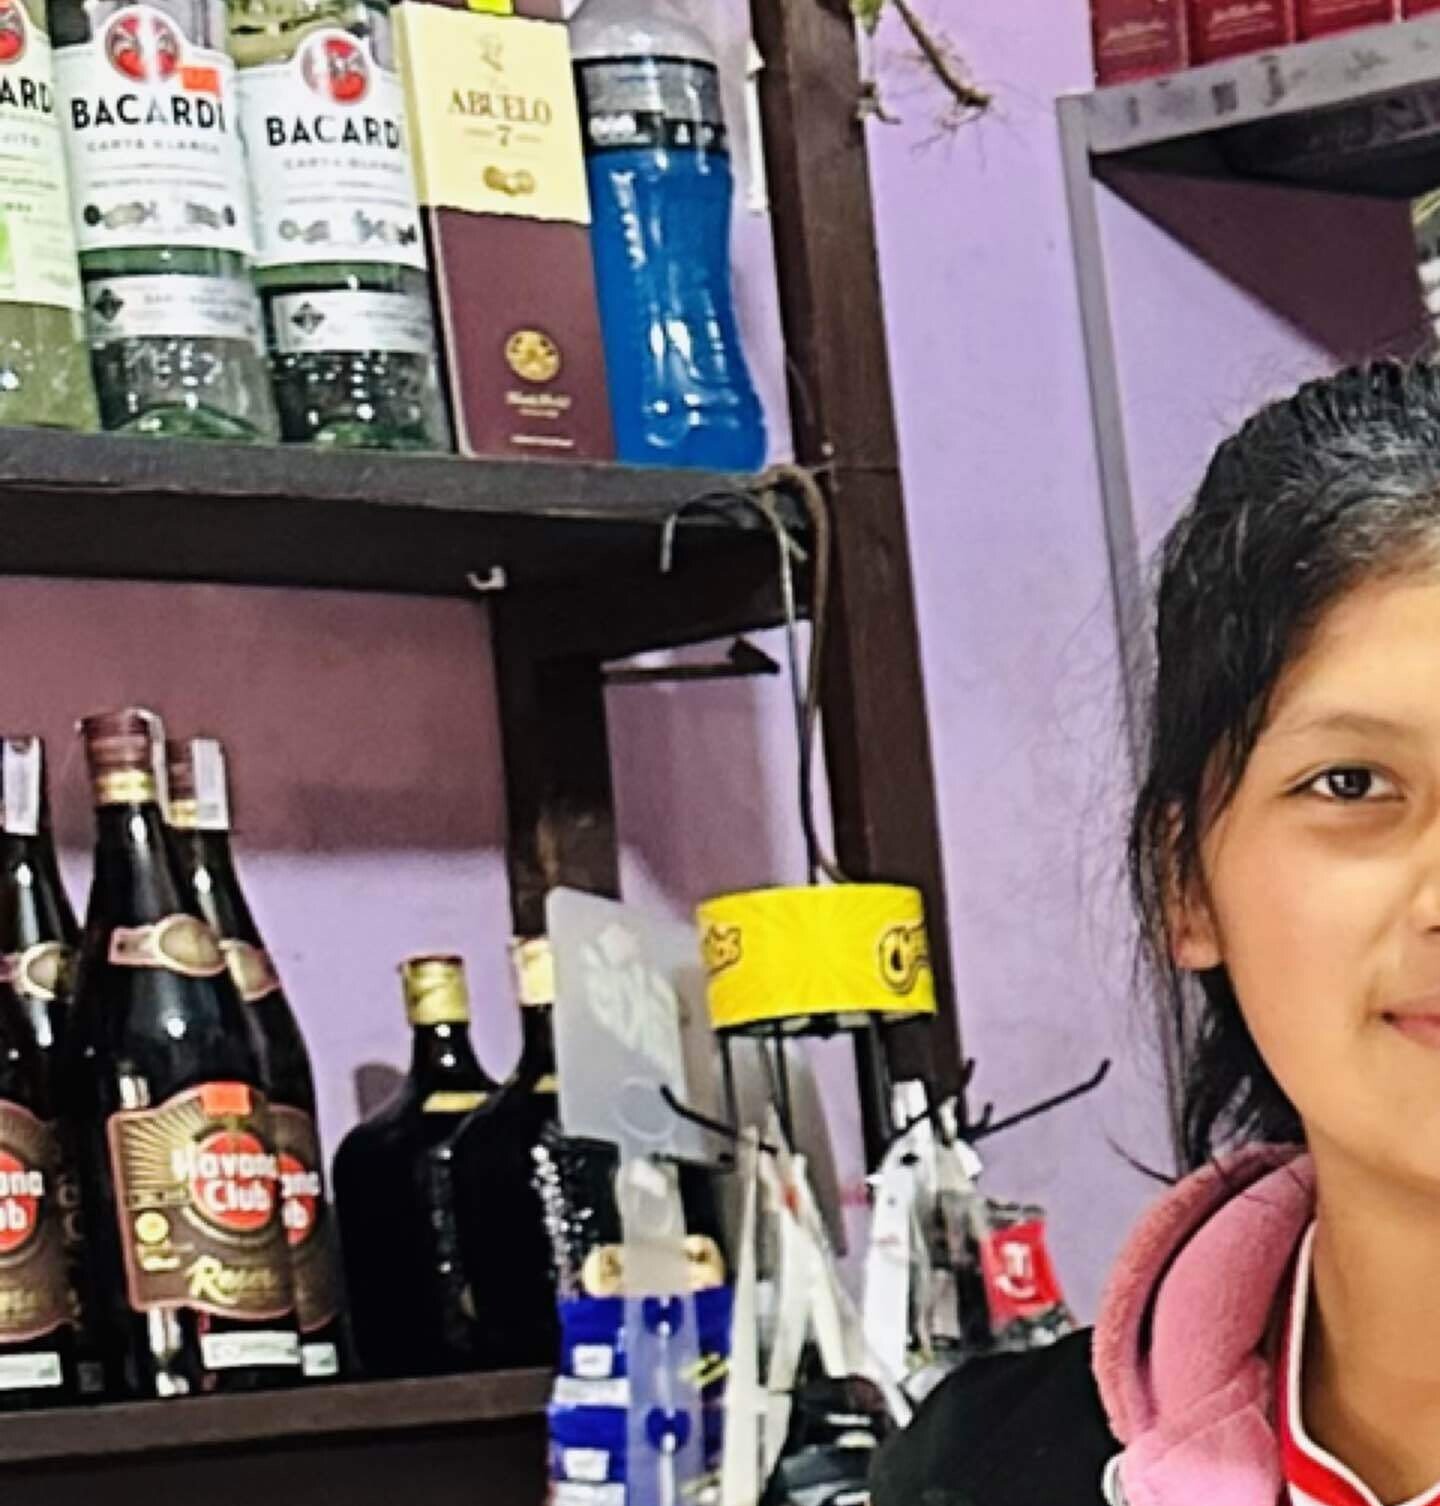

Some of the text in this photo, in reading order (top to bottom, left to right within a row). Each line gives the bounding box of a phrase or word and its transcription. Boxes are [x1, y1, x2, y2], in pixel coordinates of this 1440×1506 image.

[70, 93, 228, 135] BACARDI
[448, 89, 553, 126] ABUELO
[266, 116, 402, 149] BACARD
[496, 124, 513, 147] 7
[205, 1178, 274, 1213] Club
